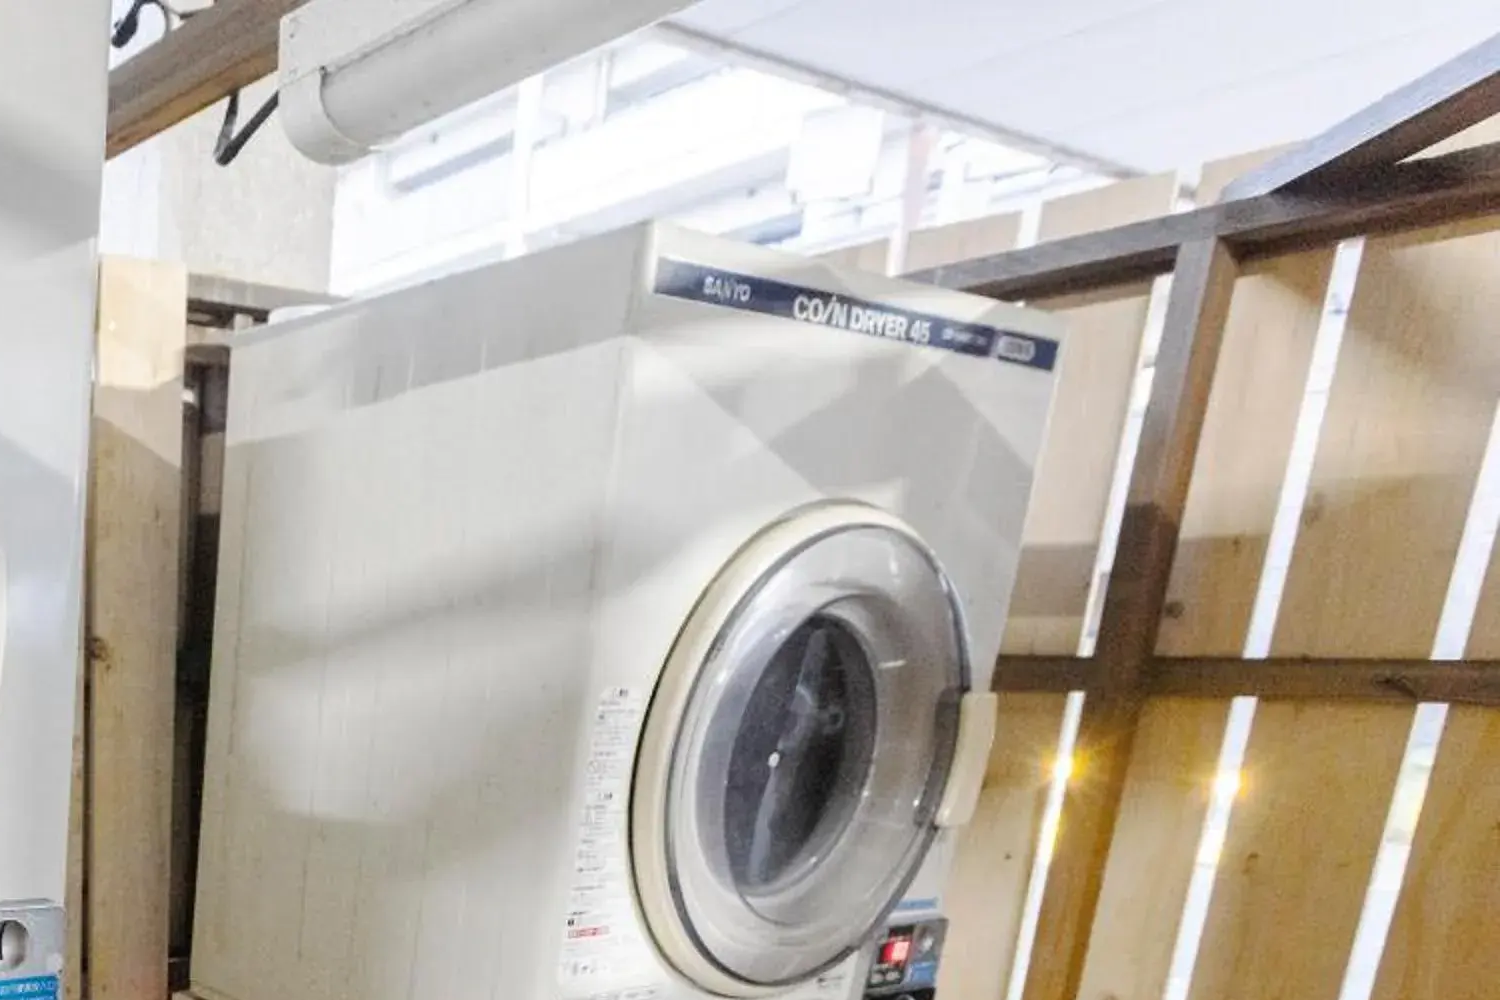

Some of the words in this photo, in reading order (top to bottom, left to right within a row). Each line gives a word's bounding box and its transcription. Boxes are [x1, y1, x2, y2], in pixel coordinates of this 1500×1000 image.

[702, 275, 752, 302] SANYO
[850, 306, 907, 340] DRYER
[910, 319, 932, 344] 45
